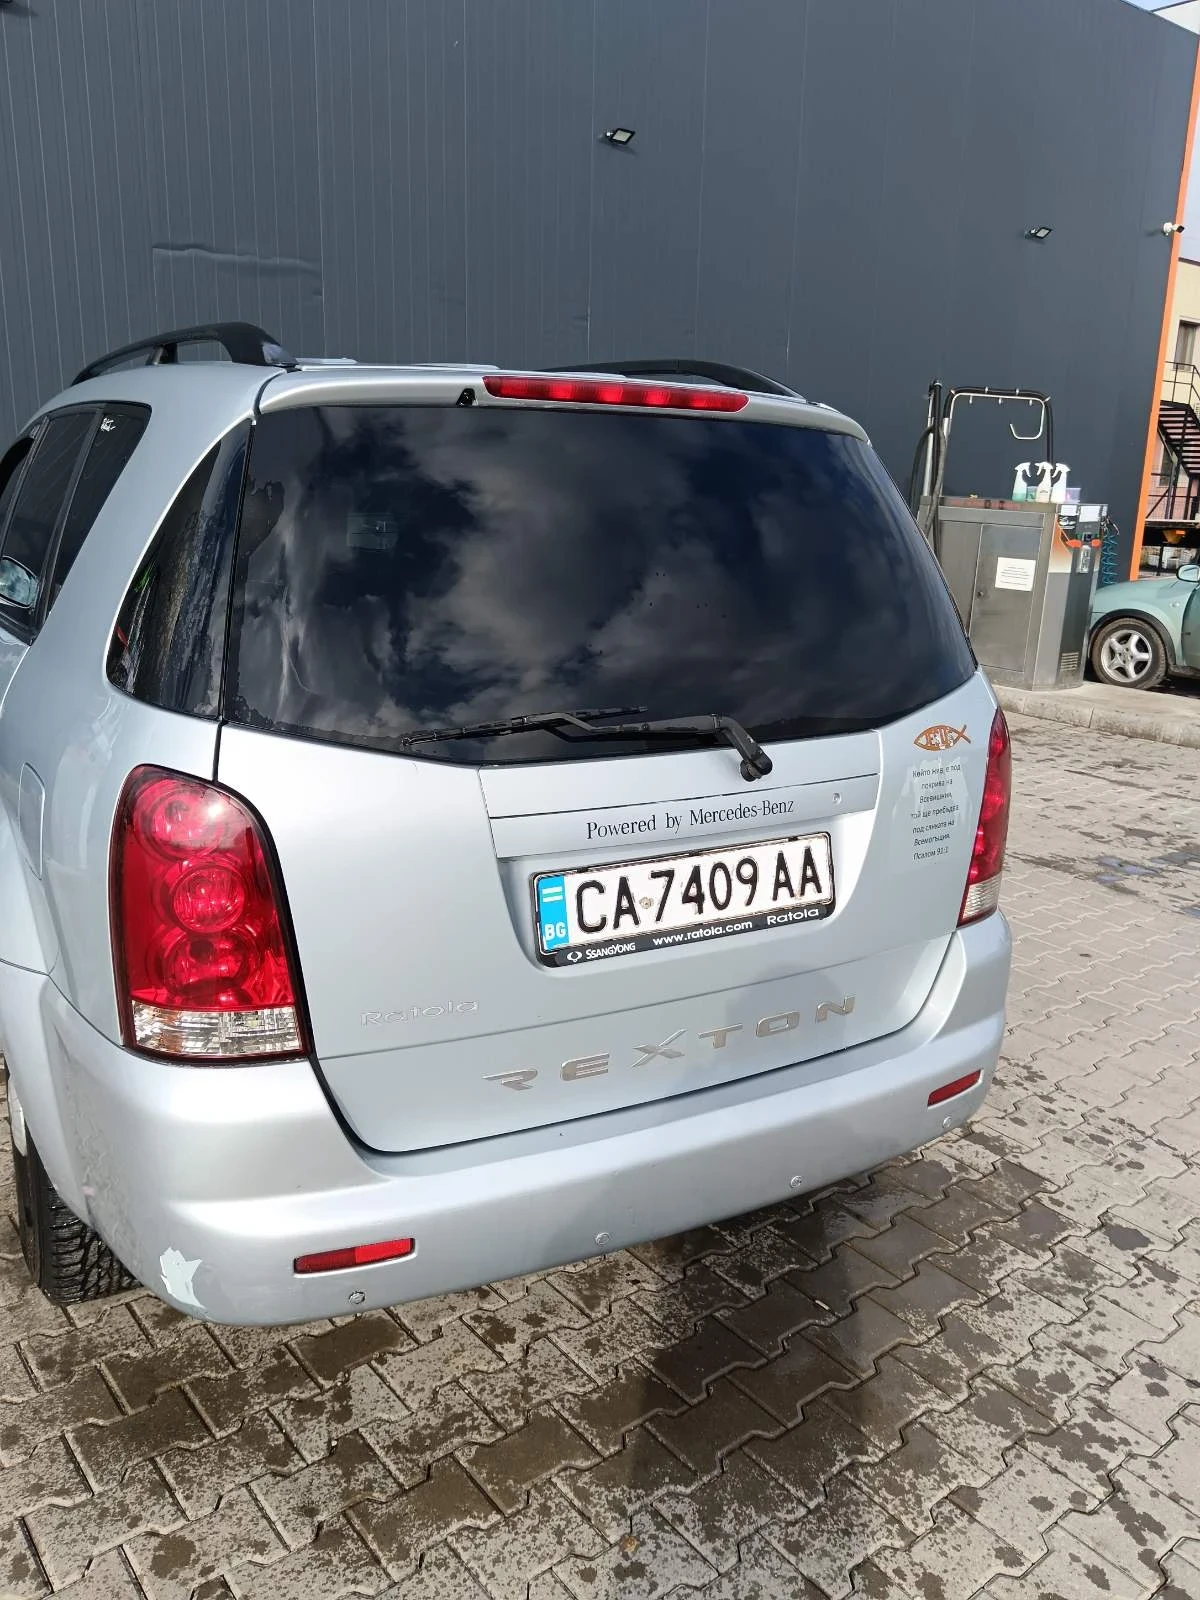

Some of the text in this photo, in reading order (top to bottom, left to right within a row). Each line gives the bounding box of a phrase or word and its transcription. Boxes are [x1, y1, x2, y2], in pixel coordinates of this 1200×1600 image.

[586, 800, 795, 839] Powered by Mercedes-Benz
[913, 850, 936, 860] Псалом
[650, 856, 759, 923] 7409
[772, 846, 823, 902] AA
[545, 922, 568, 939] BG
[652, 920, 753, 946] www.ratola.com
[766, 907, 820, 926] Ratola
[360, 999, 479, 1029] Ratola
[481, 994, 857, 1092] REXTON
